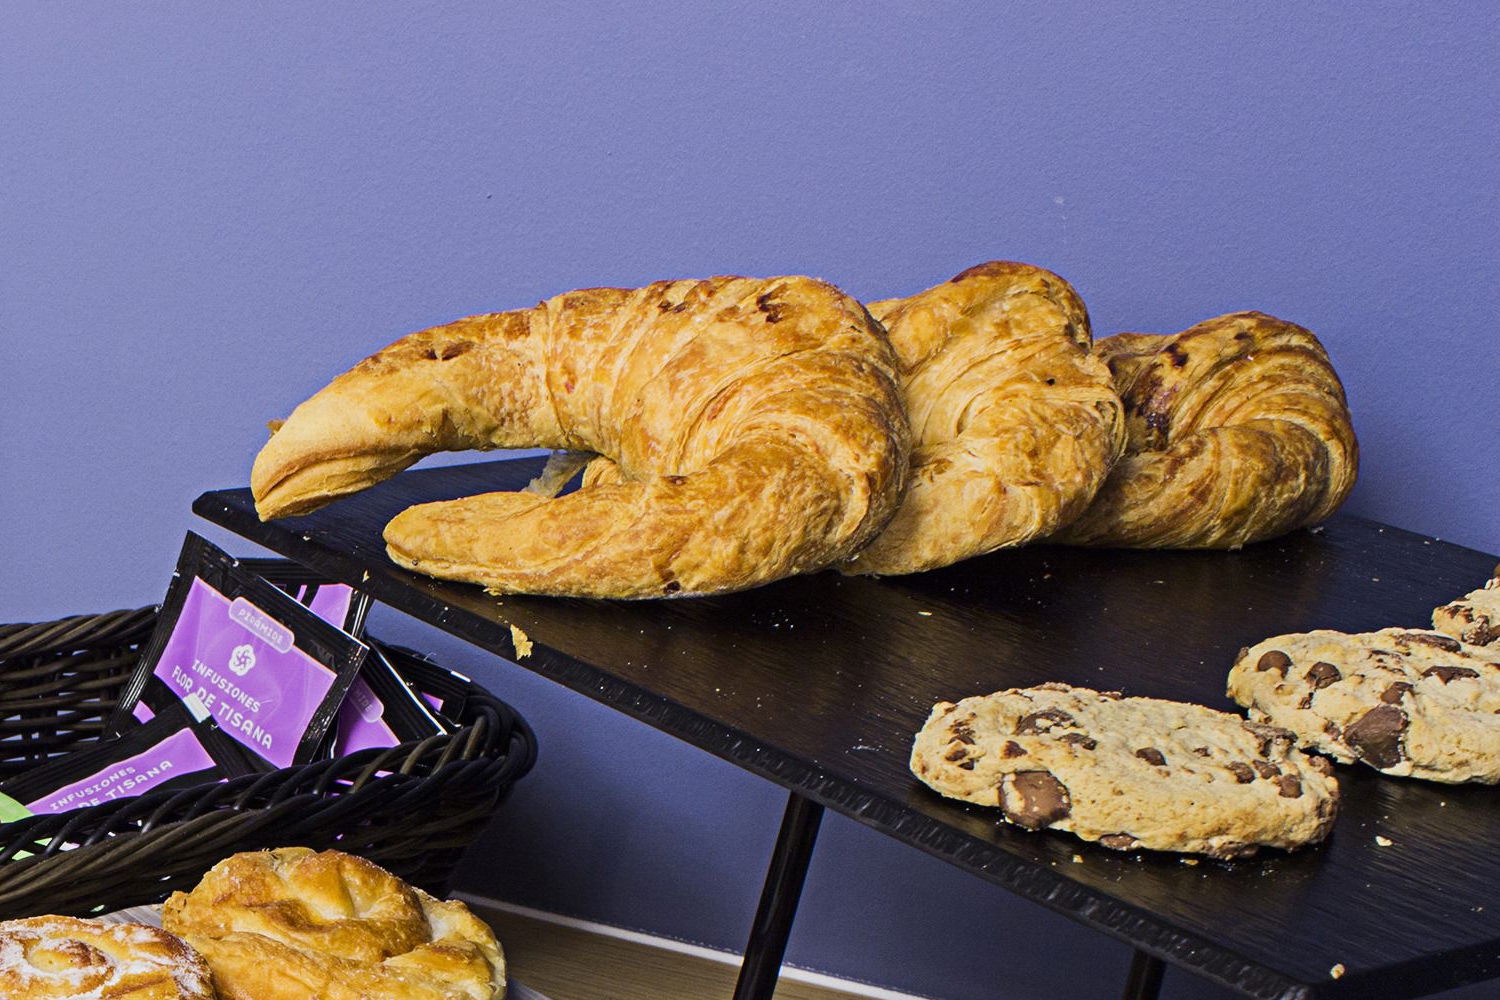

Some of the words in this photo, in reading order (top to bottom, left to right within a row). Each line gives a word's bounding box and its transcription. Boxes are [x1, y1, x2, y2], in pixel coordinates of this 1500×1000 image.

[171, 664, 194, 693] FLOR
[195, 686, 217, 708] DE
[217, 701, 273, 750] TISANA
[191, 659, 261, 713] INFUSIONES
[49, 766, 137, 811] INFUSIONES
[104, 759, 173, 800] TISANA
